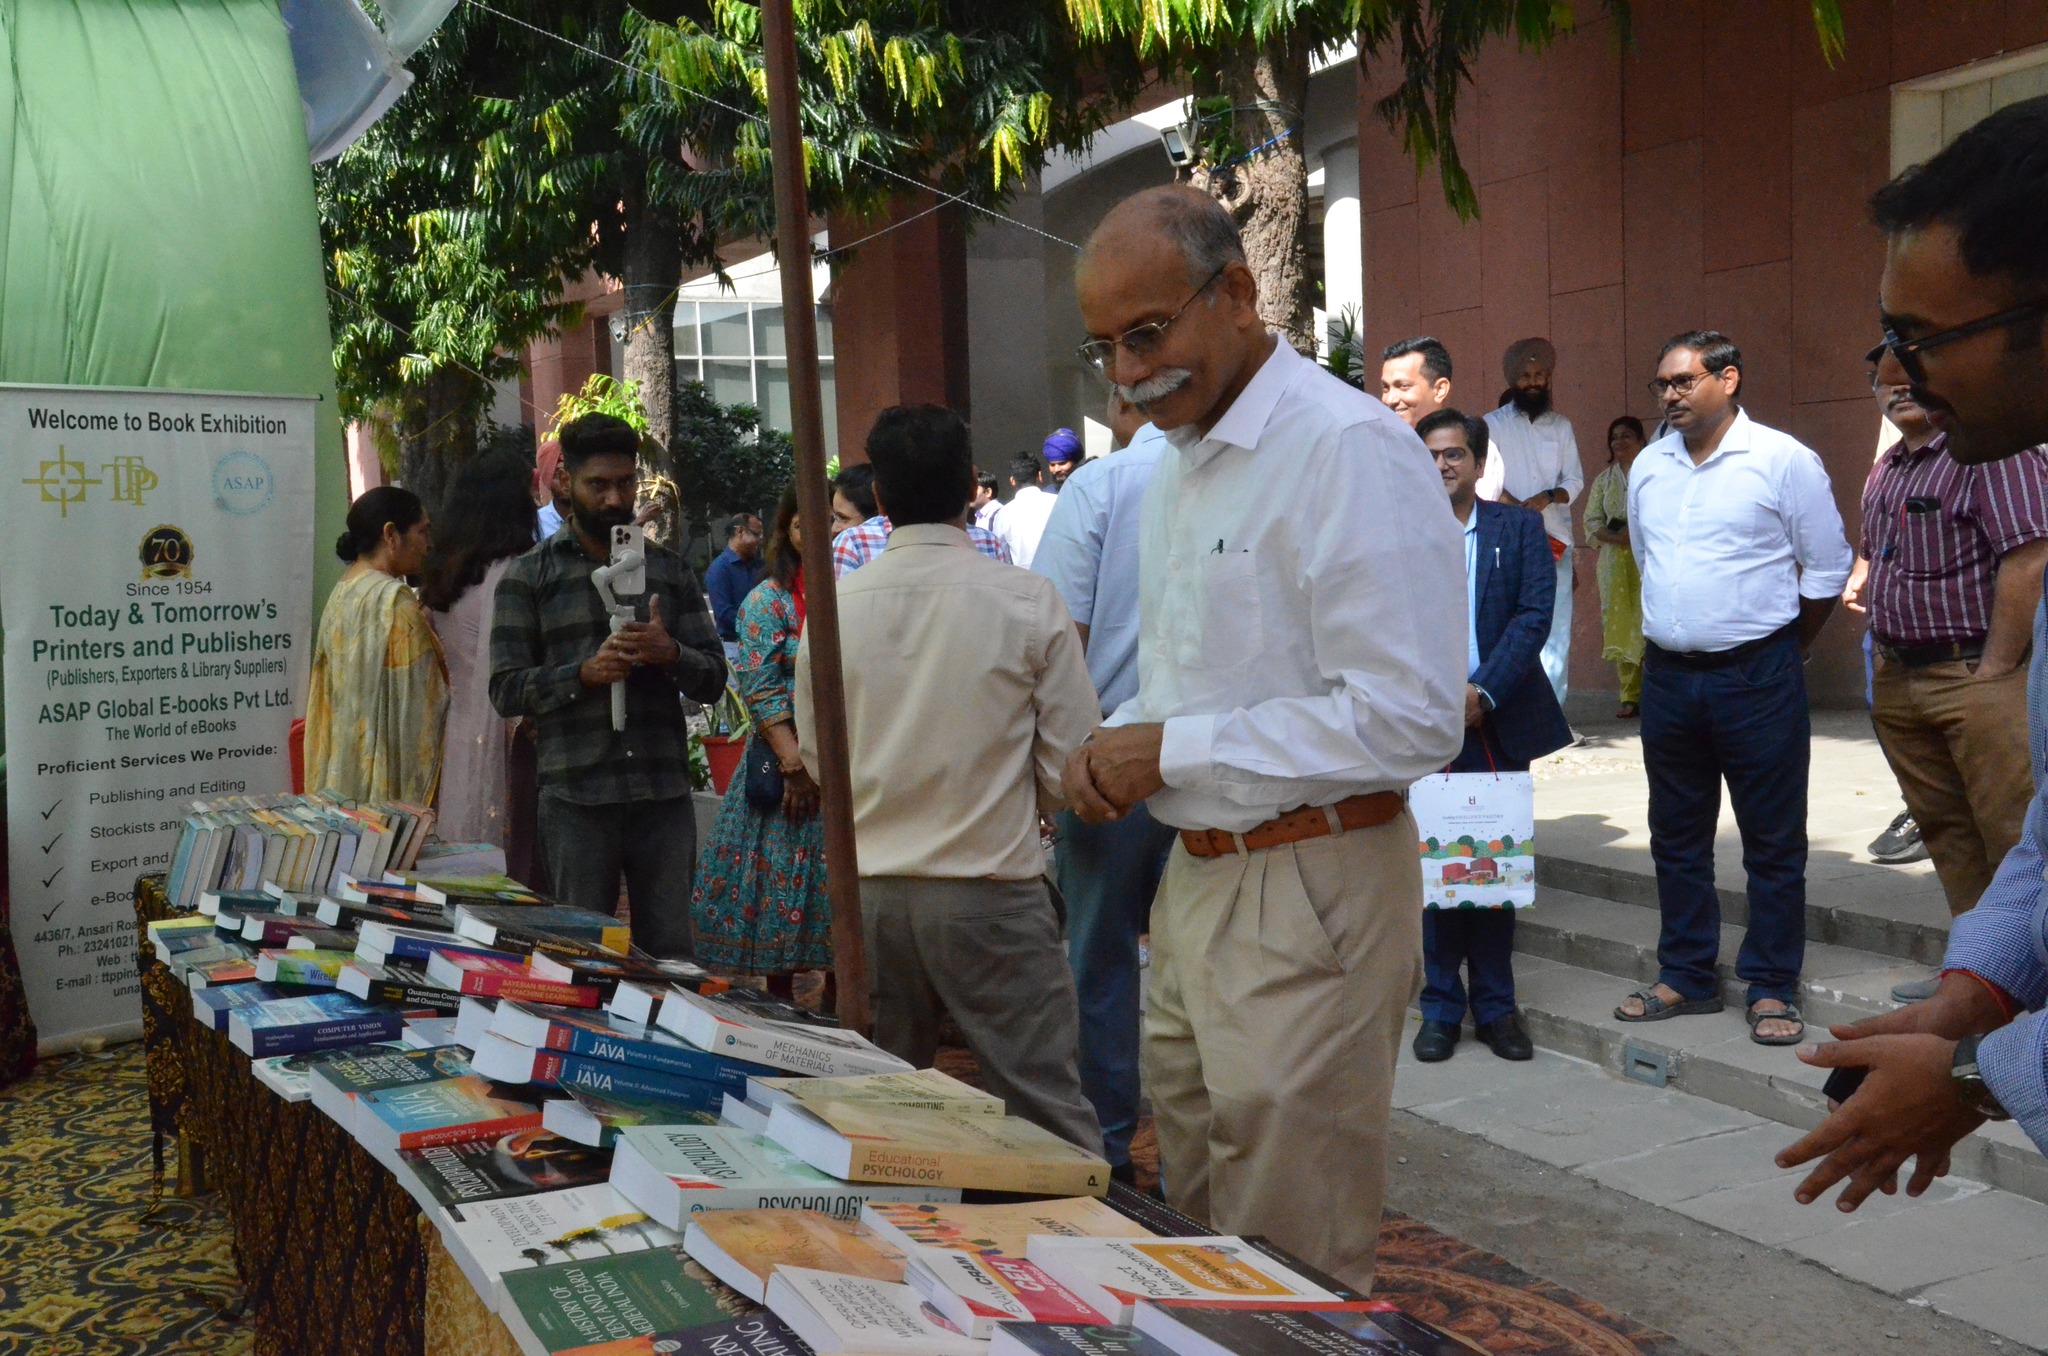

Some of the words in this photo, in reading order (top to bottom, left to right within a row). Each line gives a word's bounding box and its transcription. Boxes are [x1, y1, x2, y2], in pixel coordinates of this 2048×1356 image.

[28, 408, 118, 431] Welcome
[125, 412, 142, 431] to
[148, 412, 195, 433] Book
[201, 413, 287, 434] Exhibition
[223, 477, 264, 490] ASAP
[151, 538, 181, 562] 70
[126, 583, 170, 596] Since
[175, 581, 212, 595] 1954
[50, 604, 120, 631] Today
[128, 603, 144, 625] &
[152, 599, 277, 624] Tomorrow's
[33, 639, 125, 662] Printers
[133, 634, 174, 657] and
[182, 630, 292, 655] Publishers
[47, 668, 119, 691] (Publishers,
[122, 663, 177, 684] Exporters
[180, 662, 189, 678] &
[192, 661, 231, 680] Library
[234, 656, 288, 677] Suppliers)
[39, 702, 91, 724] ASAP
[97, 698, 154, 720] Global
[160, 693, 228, 716] E-books
[234, 690, 260, 709] Pvt
[265, 688, 292, 706] Ltd.
[106, 725, 130, 741] The
[133, 721, 171, 739] World
[175, 720, 189, 736] of
[191, 718, 237, 734] eBooks
[38, 757, 116, 776] Proficient
[120, 752, 186, 768] Services
[190, 749, 213, 762] We
[218, 744, 278, 760] Provide:
[90, 787, 165, 806] Publishing
[169, 782, 196, 798] and
[200, 779, 246, 796] Editing
[90, 821, 155, 839] Stockists
[91, 856, 138, 873] Export
[142, 852, 169, 866] and
[91, 890, 135, 906] e-Boo
[78, 921, 113, 938] Ansari
[116, 920, 138, 932] Roa
[97, 953, 120, 967] Web
[56, 974, 91, 991] E-mail
[309, 968, 339, 982] Wirele
[502, 979, 537, 990] BAYESIAN
[538, 983, 579, 994] REASONING
[113, 984, 140, 997] unna
[407, 988, 440, 998] Quantum
[441, 992, 461, 1003] Comp
[511, 989, 544, 999] MACHINE
[544, 993, 581, 1003] LEARNING
[420, 998, 453, 1008] Quantum
[318, 1024, 356, 1035] COMPUTER
[358, 1022, 382, 1031] VISION
[588, 1042, 625, 1061] JAVA
[626, 1049, 648, 1059] Volume
[653, 1055, 692, 1069] Fundamentals
[735, 1038, 759, 1050] Pearson
[773, 1040, 832, 1062] MECHANICS
[579, 1063, 595, 1071] CORE
[765, 1049, 777, 1060] OF
[780, 1053, 834, 1074] MATERIALS
[576, 1069, 612, 1091] JAVA
[640, 1084, 666, 1095] Advanced
[392, 1089, 459, 1121] JAVA
[422, 1129, 467, 1142] INTRODUCTION
[467, 1127, 477, 1135] TO
[664, 1132, 743, 1180] PSYCHOLOGY
[869, 1151, 941, 1168] Educational
[862, 1164, 944, 1180] PSYCHOLOGY
[485, 1204, 530, 1247] DEVELOPMENT
[515, 1212, 545, 1237] ACROSS
[563, 1268, 595, 1294] EARLY
[952, 1255, 993, 1285] CRAM
[991, 1261, 1046, 1291] CEH
[1106, 1243, 1199, 1296] Management
[1117, 1266, 1171, 1296] Project
[1167, 1253, 1233, 1290] ABSOLUTE
[1224, 1267, 1267, 1290] GUIDE
[549, 1285, 572, 1299] OF
[594, 1271, 625, 1296] INDIA
[582, 1293, 606, 1314] AND
[558, 1298, 600, 1336] HISTORY
[598, 1315, 632, 1341] CIENT
